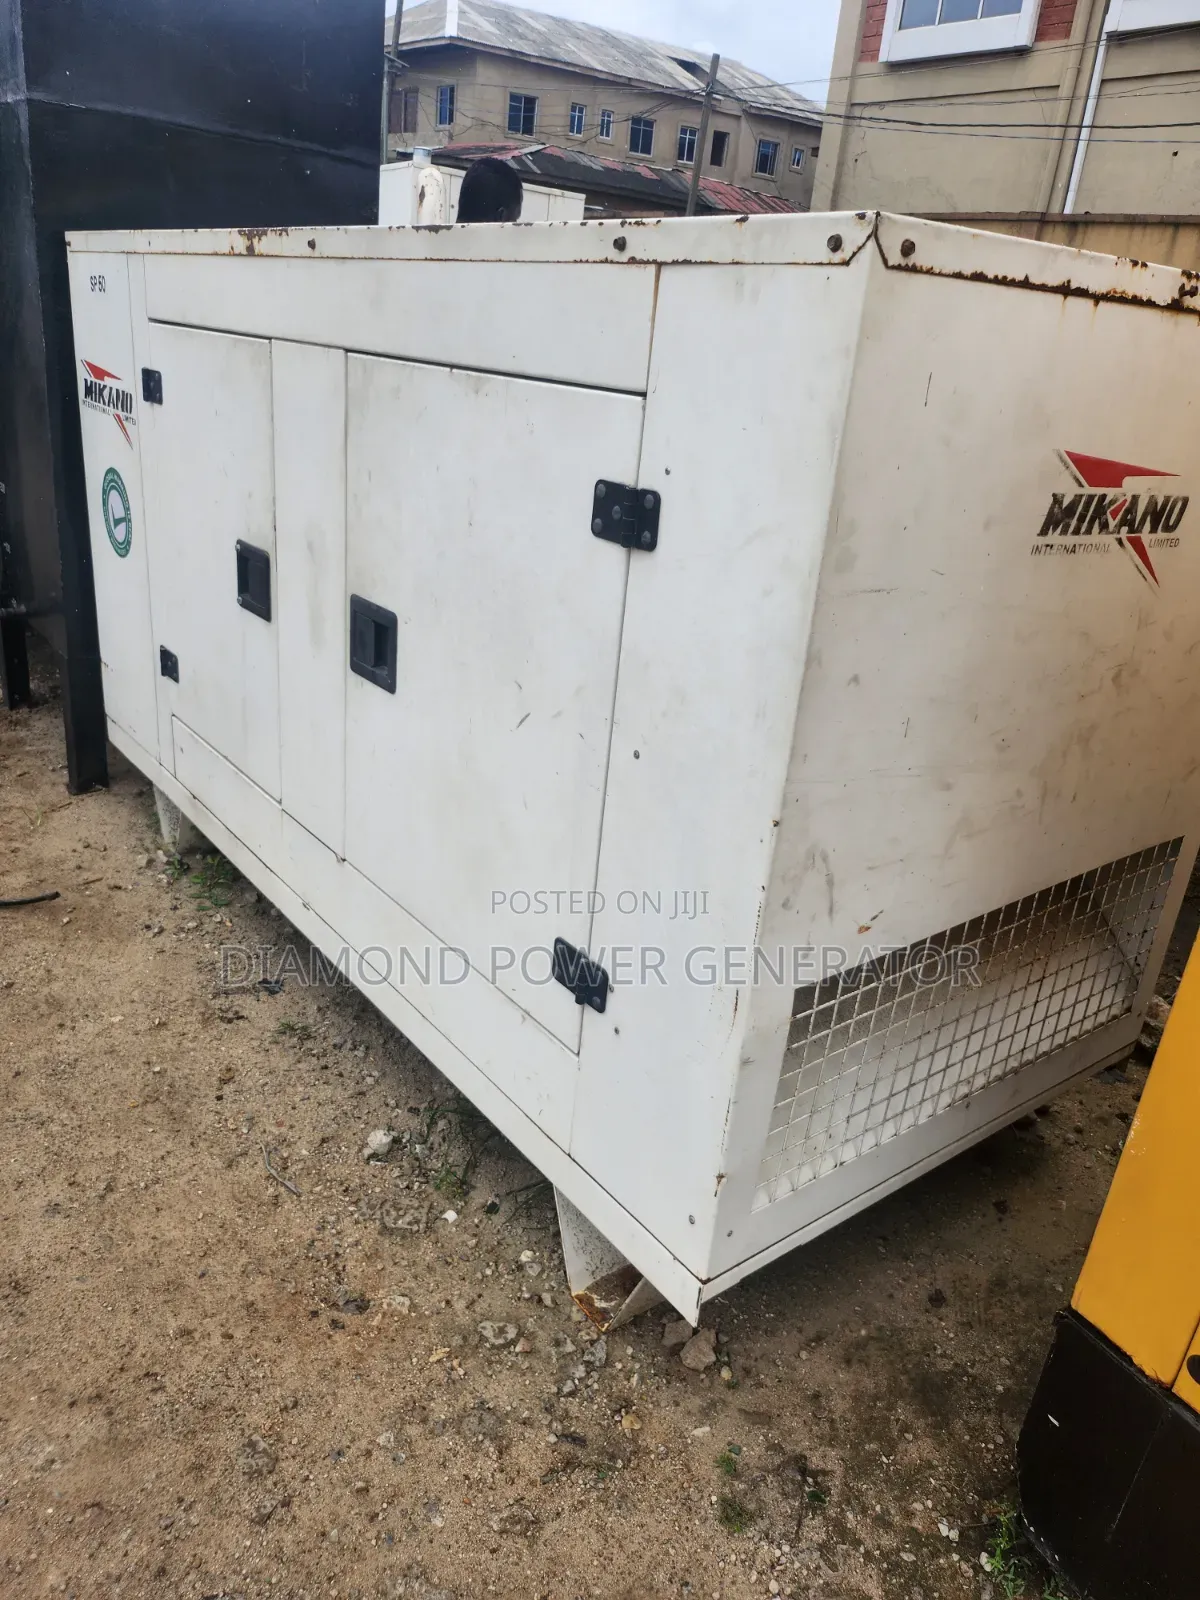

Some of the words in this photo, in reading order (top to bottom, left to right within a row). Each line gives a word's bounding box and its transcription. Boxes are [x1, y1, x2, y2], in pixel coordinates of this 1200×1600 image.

[90, 276, 97, 292] SP
[98, 274, 106, 293] 50
[84, 378, 133, 414] MIKANO
[1036, 493, 1190, 537] MIKANO
[1030, 543, 1111, 557] INTERNATIONAL
[1148, 538, 1180, 549] LIMITED
